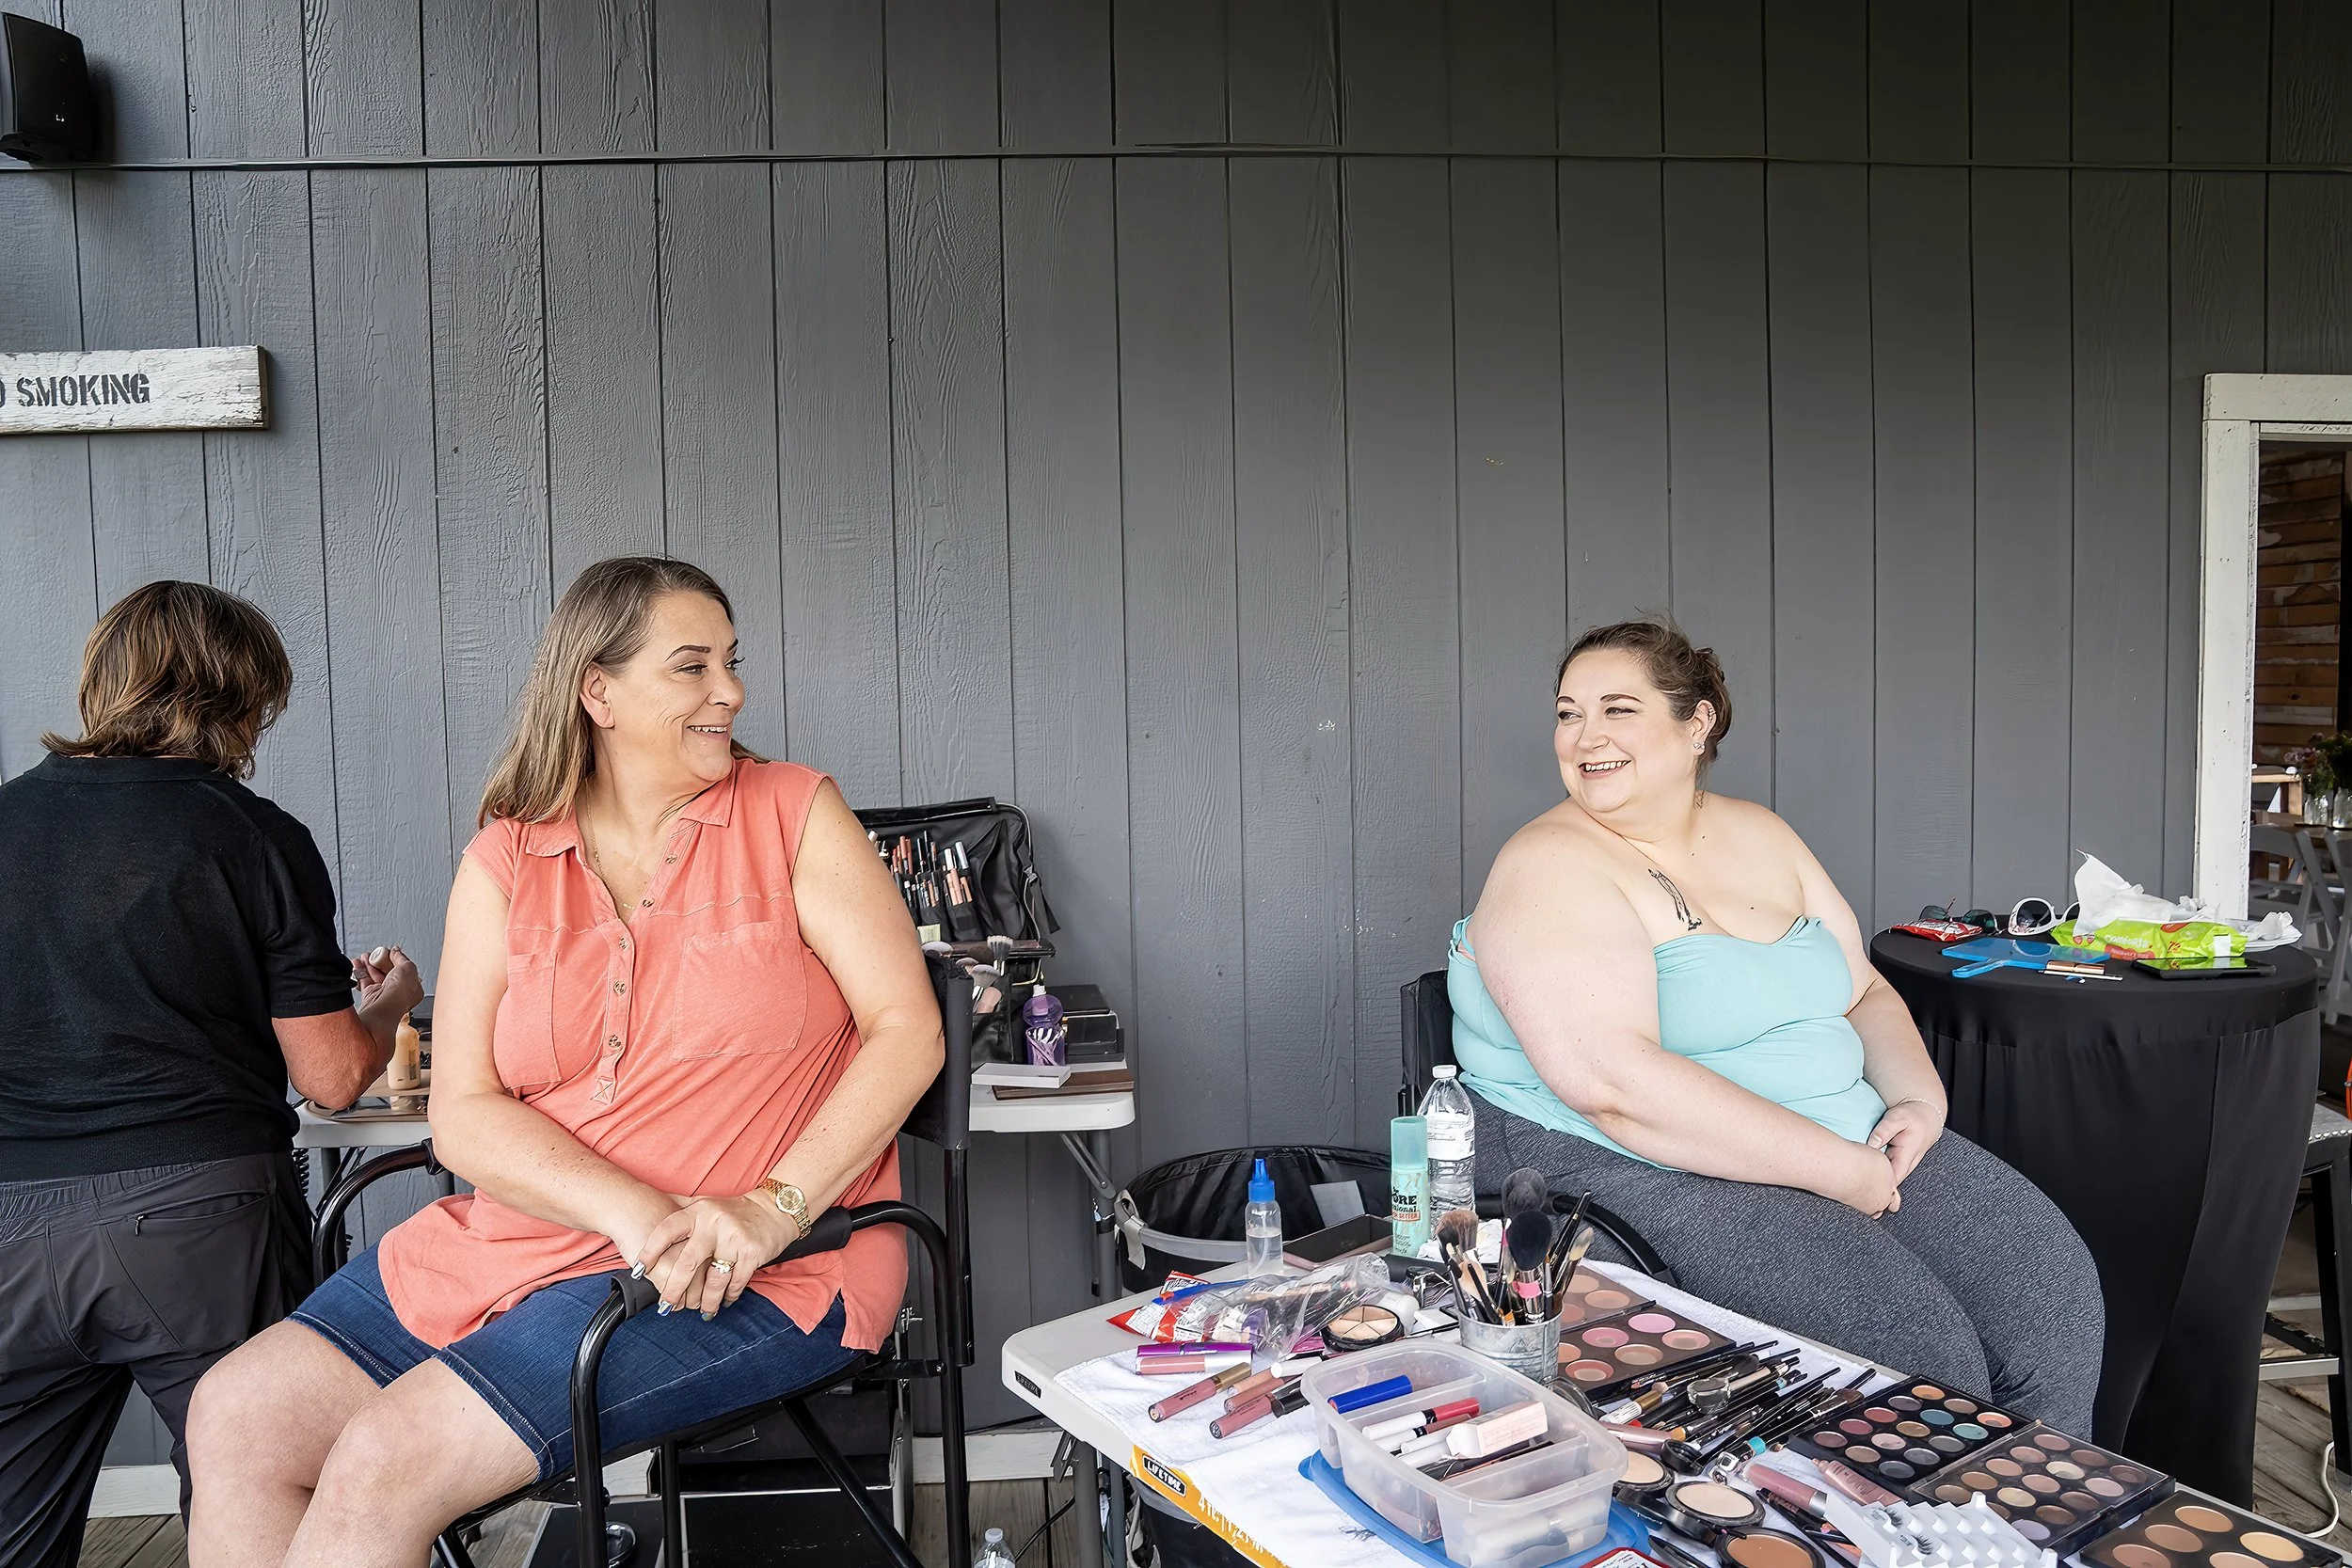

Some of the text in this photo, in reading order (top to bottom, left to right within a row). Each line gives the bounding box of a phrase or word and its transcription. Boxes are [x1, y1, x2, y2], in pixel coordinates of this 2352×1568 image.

[17, 373, 151, 407] SMOKING
[1392, 1192, 1417, 1205] ORE
[1146, 1460, 1183, 1492] LIFETIME
